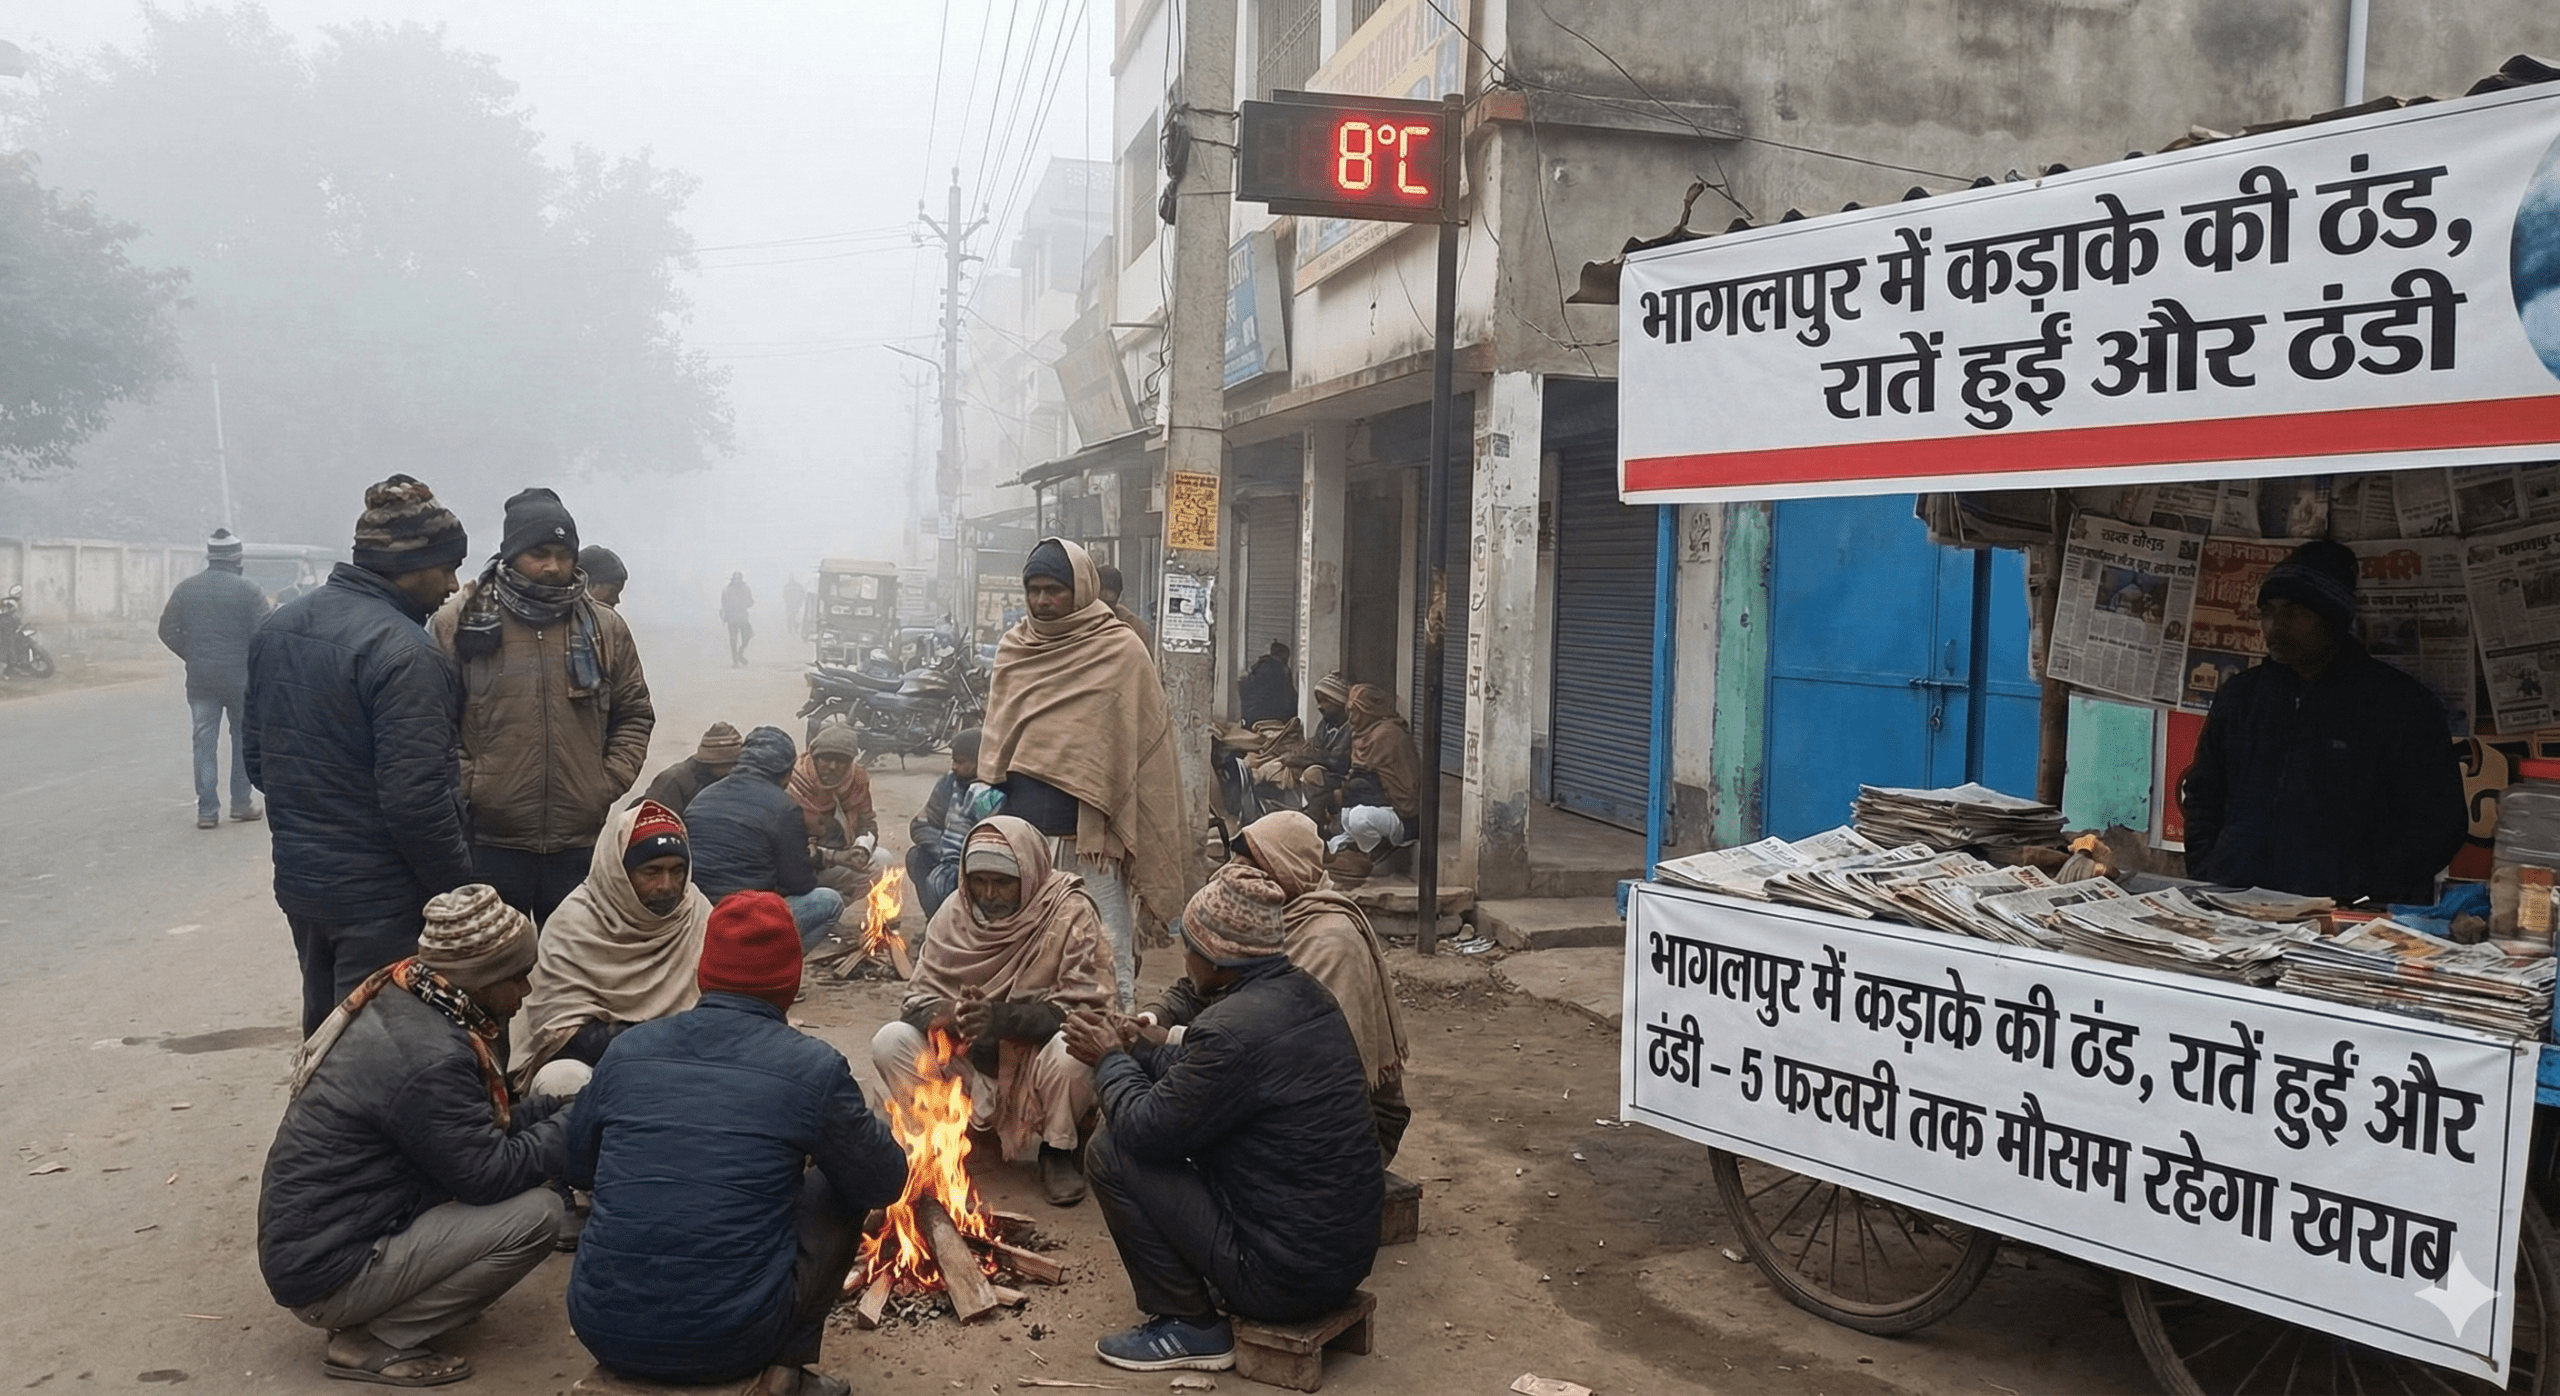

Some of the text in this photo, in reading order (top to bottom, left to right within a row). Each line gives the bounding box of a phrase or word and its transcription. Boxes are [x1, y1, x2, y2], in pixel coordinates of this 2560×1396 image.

[1640, 153, 2472, 348] भागलपुर में कड़ाके की ठंड,
[1820, 268, 2468, 431] रातें हुईं और ठंडी
[1646, 1011, 1705, 1089] ठंडी
[1740, 1046, 1764, 1103] 5
[1773, 1058, 1901, 1141] फरवरी
[1908, 1088, 1988, 1161] तक
[1995, 1091, 2133, 1204] मौसम
[2142, 1129, 2280, 1243] रहेगा
[2290, 1181, 2459, 1292] खराब
[1649, 930, 2485, 1164] भागलपुर में कड़ाके की ठंड, रातें हुईं और
